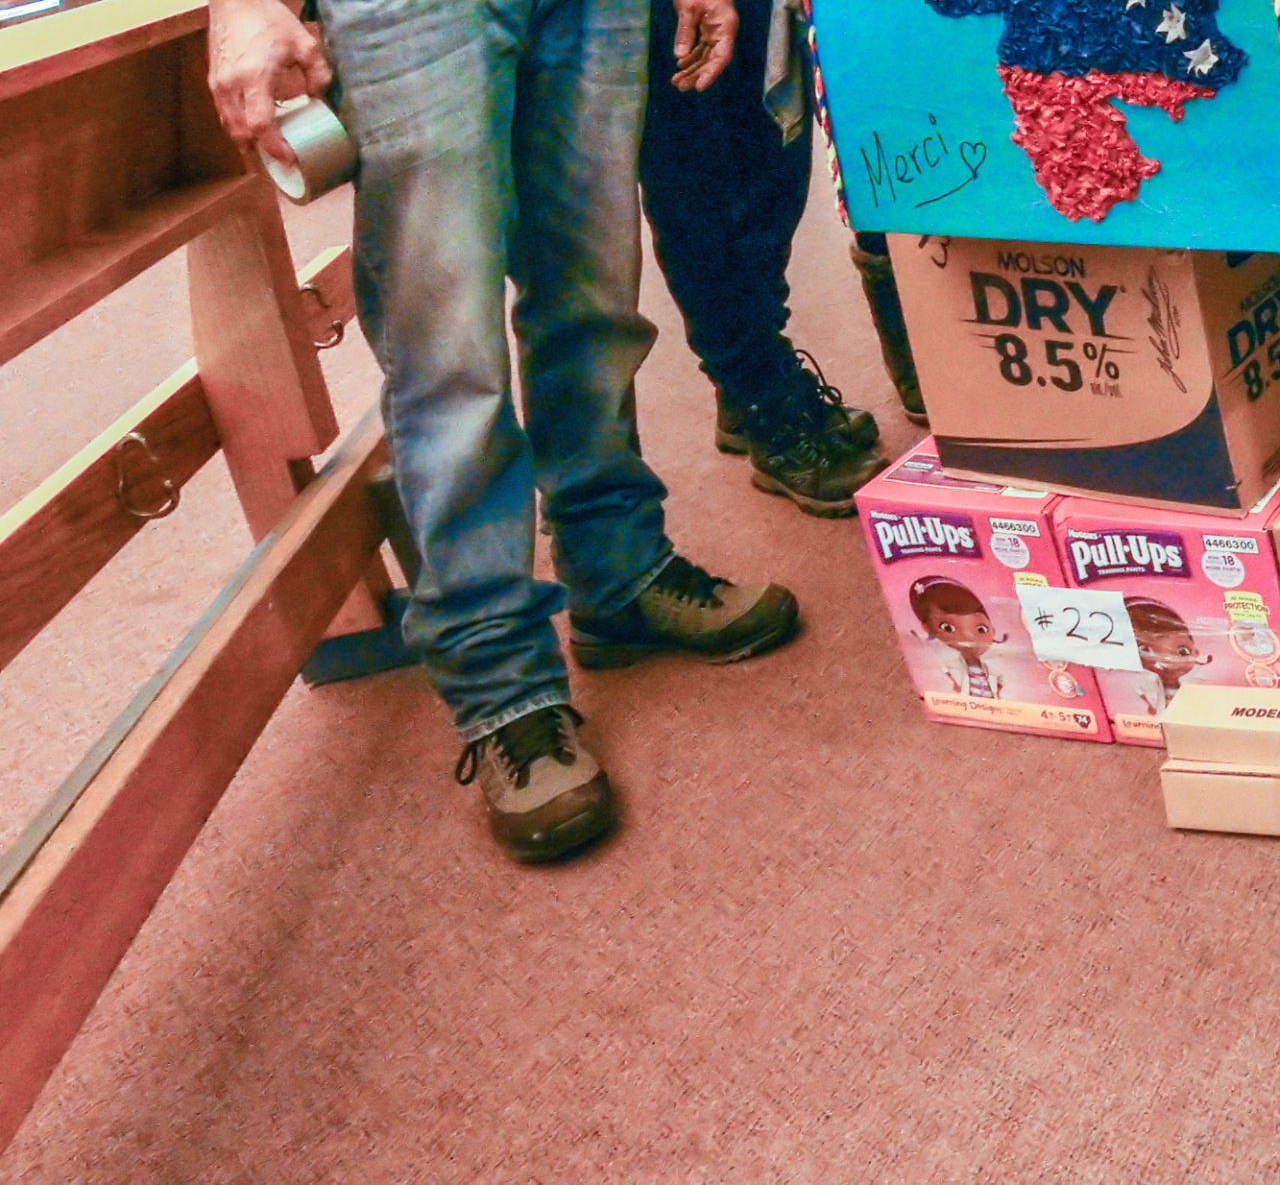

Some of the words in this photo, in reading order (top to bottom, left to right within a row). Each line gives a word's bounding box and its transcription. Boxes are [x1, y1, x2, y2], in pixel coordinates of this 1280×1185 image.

[861, 114, 947, 209] Merci
[998, 250, 1087, 278] MOLSON
[969, 270, 1119, 338] DRY
[993, 332, 1121, 393] 8.5%
[991, 520, 1037, 535] 4466300
[1008, 537, 1021, 548] 18
[1204, 538, 1255, 551] 4466300
[1221, 554, 1236, 567] 18
